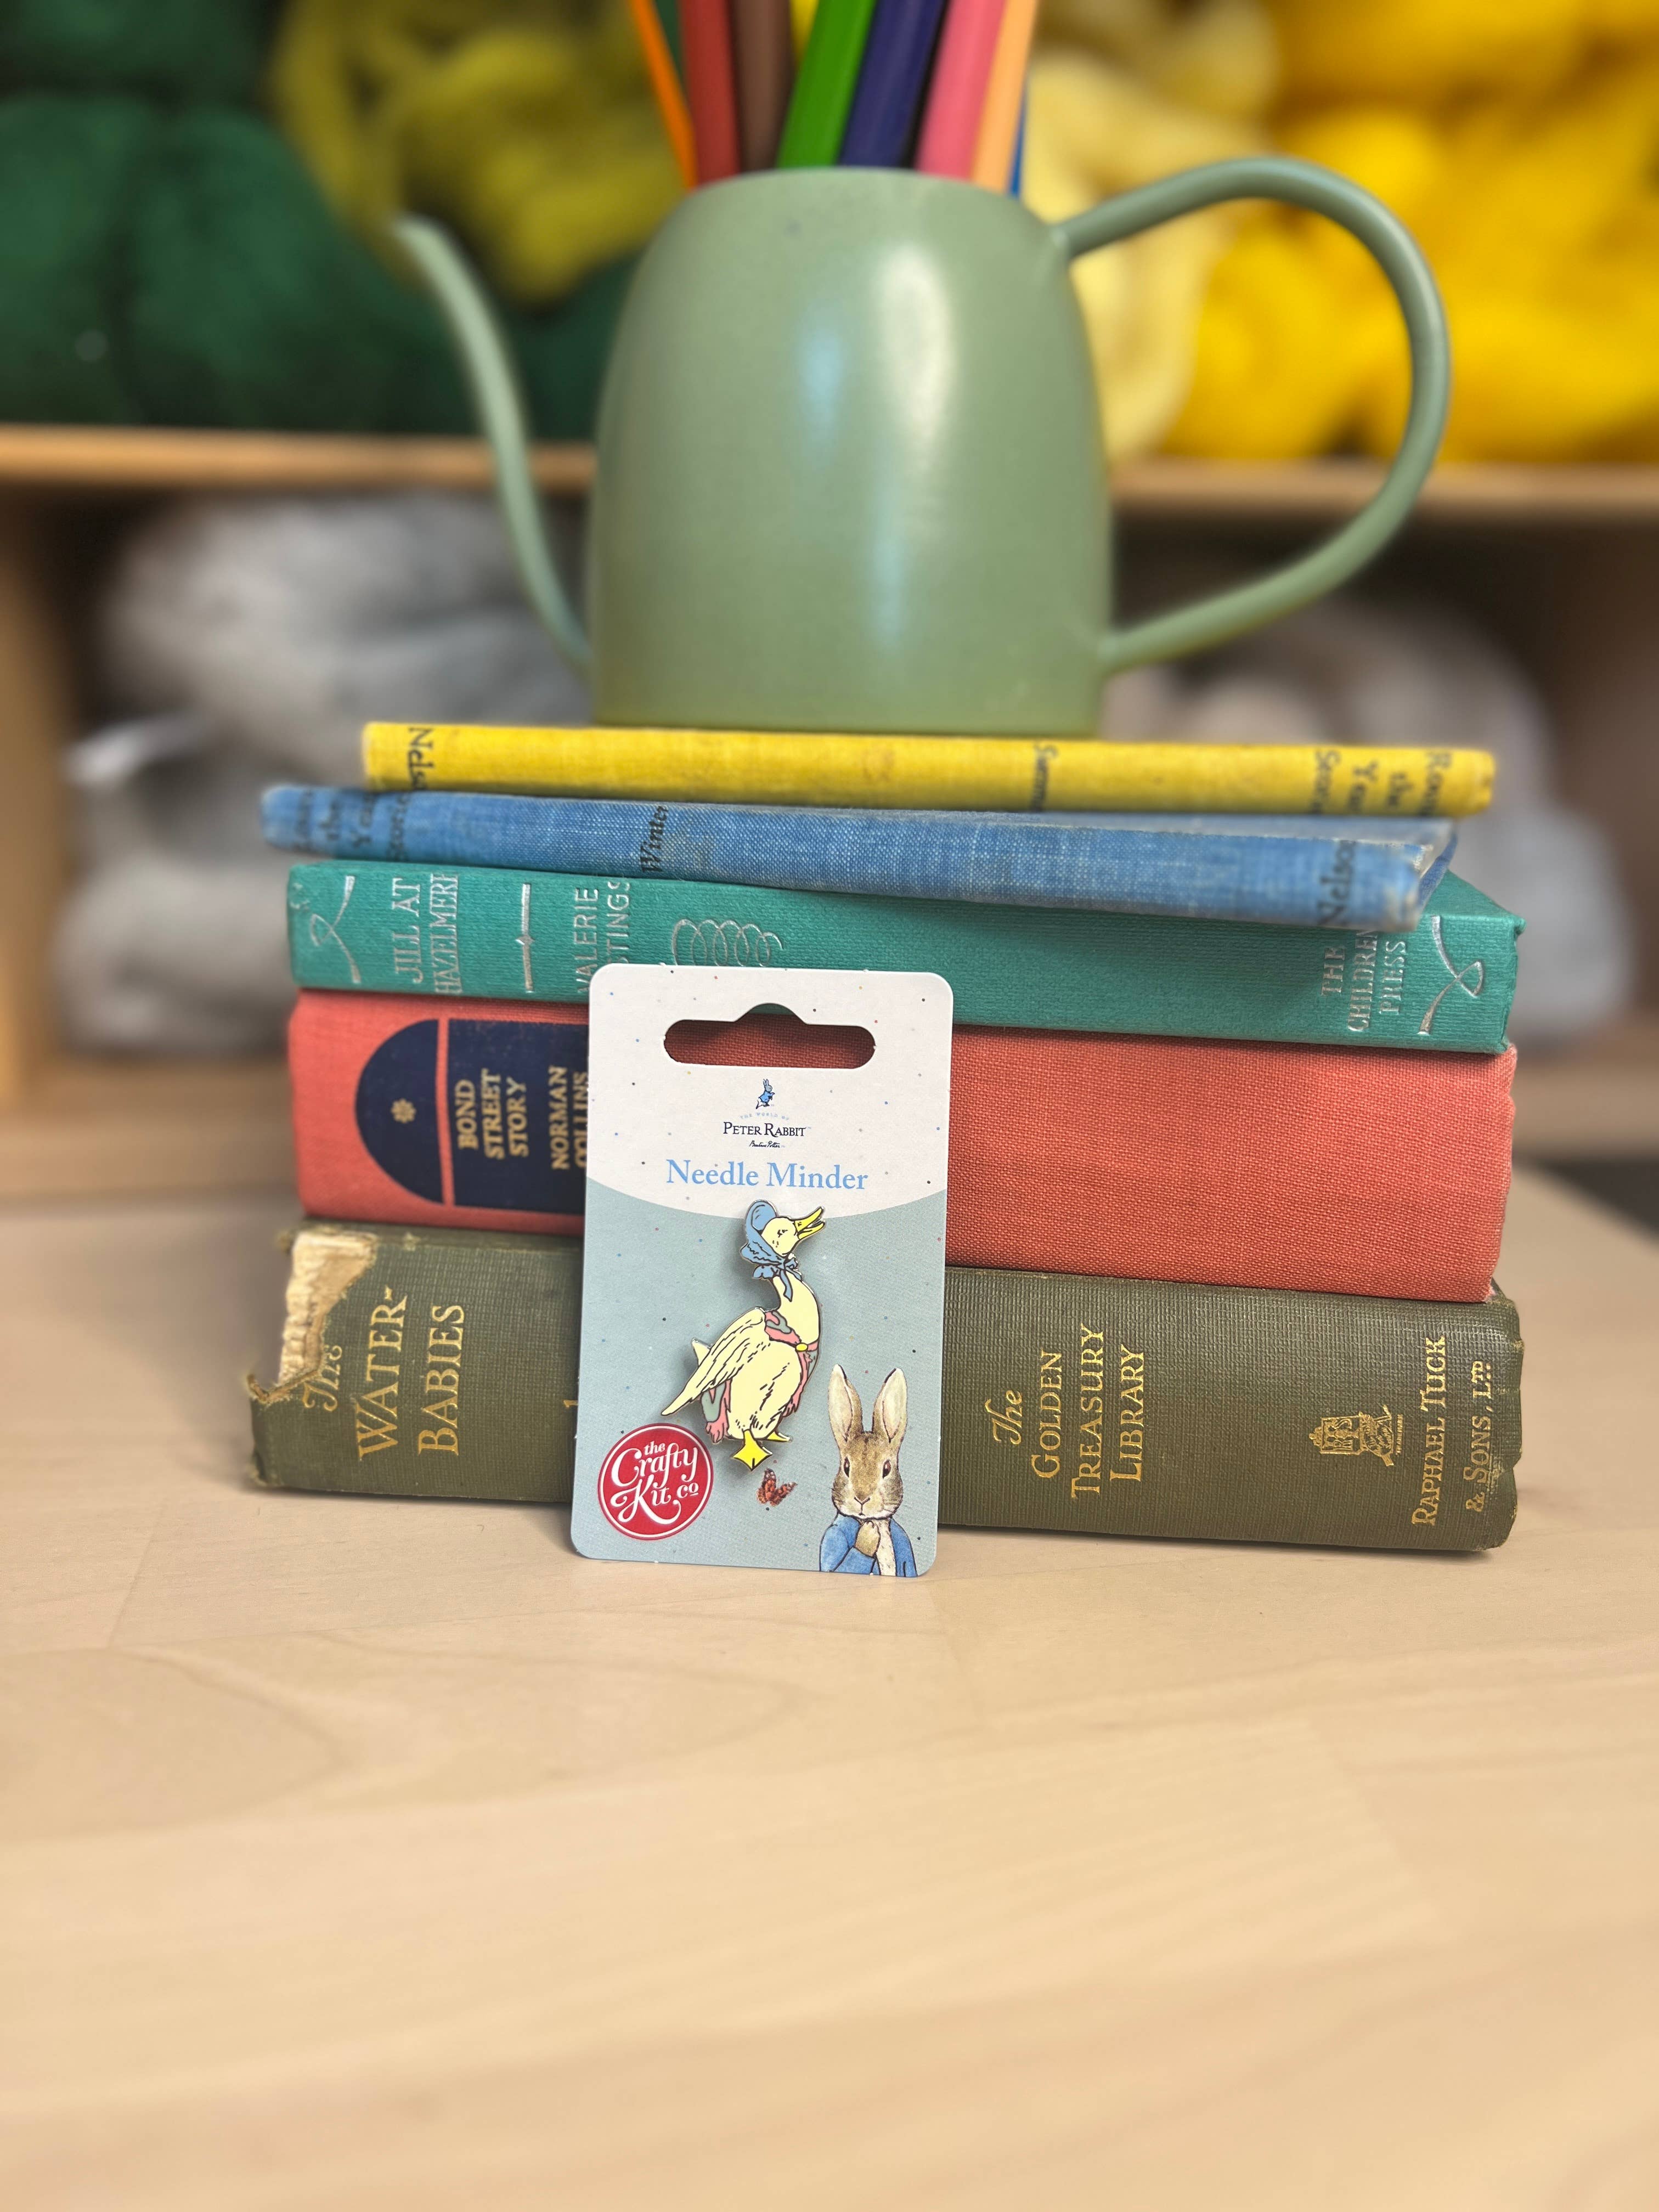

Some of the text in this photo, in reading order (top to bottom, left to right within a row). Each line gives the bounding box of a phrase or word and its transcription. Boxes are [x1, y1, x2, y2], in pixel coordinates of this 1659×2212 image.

[640, 806, 669, 873] Winter
[392, 877, 424, 984] JILL AT
[1321, 946, 1345, 996] THE
[1378, 940, 1406, 1015] PRESS
[455, 1079, 478, 1150] BOND
[482, 1068, 505, 1159] STREET
[507, 1077, 529, 1157] STORY
[548, 1065, 569, 1170] NORMAN
[723, 1121, 762, 1135] PETER
[666, 1159, 869, 1190] Needle Minder
[356, 1285, 408, 1461] WATER-
[419, 1305, 465, 1457] BABIES
[1071, 1322, 1104, 1499] TREASURY
[644, 1441, 665, 1455] the
[985, 1390, 1023, 1446] The
[1031, 1350, 1063, 1479] GOLDEN
[1110, 1344, 1144, 1483] LIBRARY
[1412, 1335, 1447, 1527] RAPHAEL TUCK
[610, 1474, 681, 1525] Kit
[611, 1442, 698, 1489] Crafty
[1465, 1492, 1485, 1513] &
